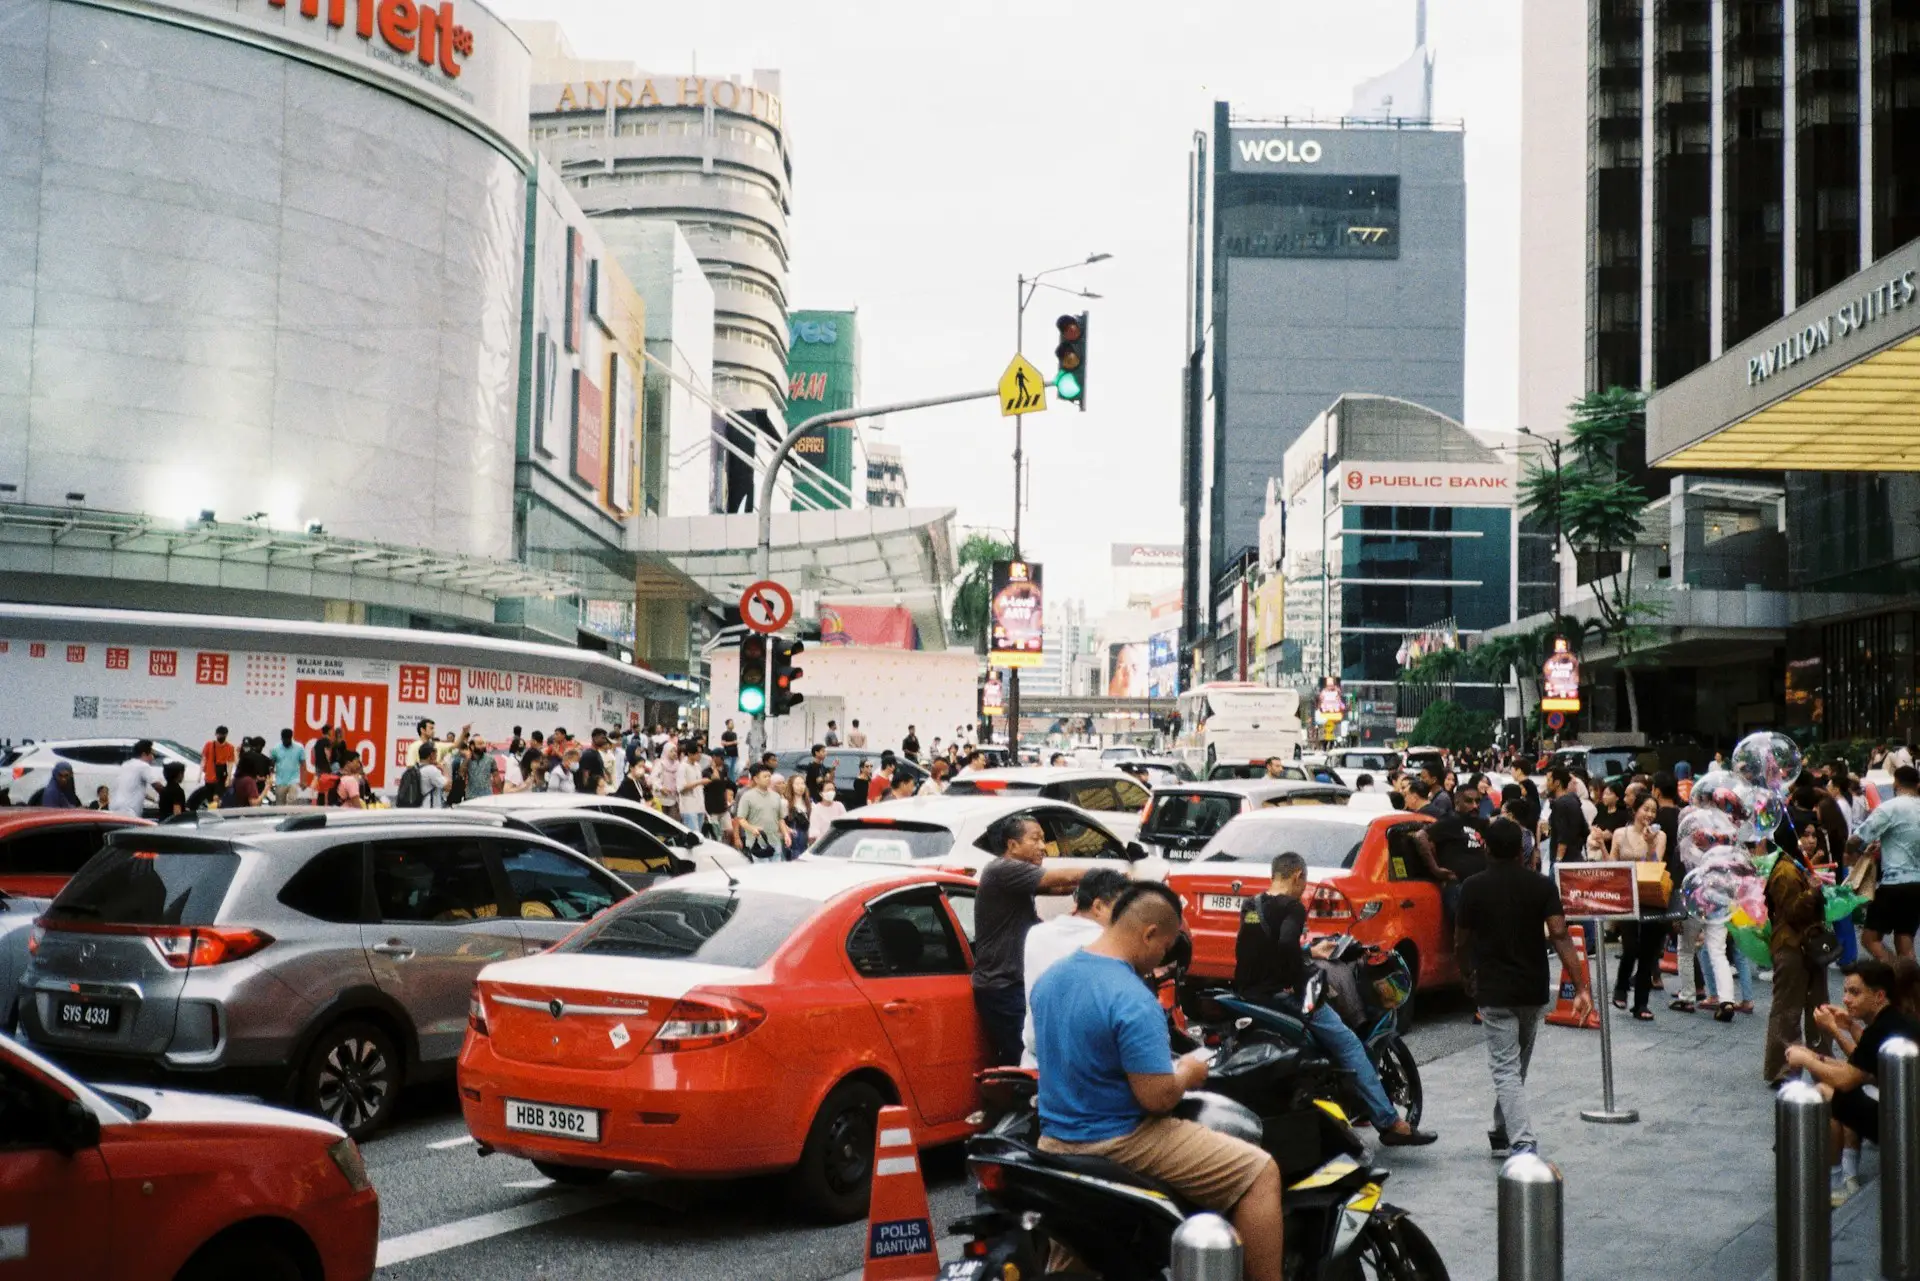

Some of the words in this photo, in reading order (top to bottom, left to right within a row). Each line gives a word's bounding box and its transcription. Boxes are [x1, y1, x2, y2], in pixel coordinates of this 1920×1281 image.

[556, 78, 662, 112] ANSA
[1238, 139, 1322, 163] WOLO
[1748, 316, 1833, 386] PAVILION
[1838, 269, 1916, 336] SUITES
[1369, 475, 1442, 488] PUBLIC
[1449, 476, 1509, 489] BANK
[152, 653, 172, 663] UNI
[296, 658, 321, 667] WAJAH
[324, 659, 343, 668] BARU
[151, 664, 173, 675] QLO
[439, 671, 458, 686] UNI
[467, 669, 512, 694] UNIQLO
[438, 687, 459, 702] QLO
[467, 695, 494, 707] WAJAH
[496, 697, 514, 709] BARU
[516, 699, 534, 711] AKAN
[305, 693, 372, 732] UNI
[1577, 869, 1614, 877] PAVILION
[1212, 896, 1232, 908] HBB
[1569, 889, 1582, 898] NO
[1583, 890, 1621, 900] PARKING
[63, 1004, 82, 1022] SYS
[85, 1007, 110, 1025] 4331
[517, 1106, 544, 1126] HBB
[549, 1110, 585, 1132] 3962
[880, 1223, 920, 1239] POLIS
[876, 1237, 927, 1255] BANTUAN
